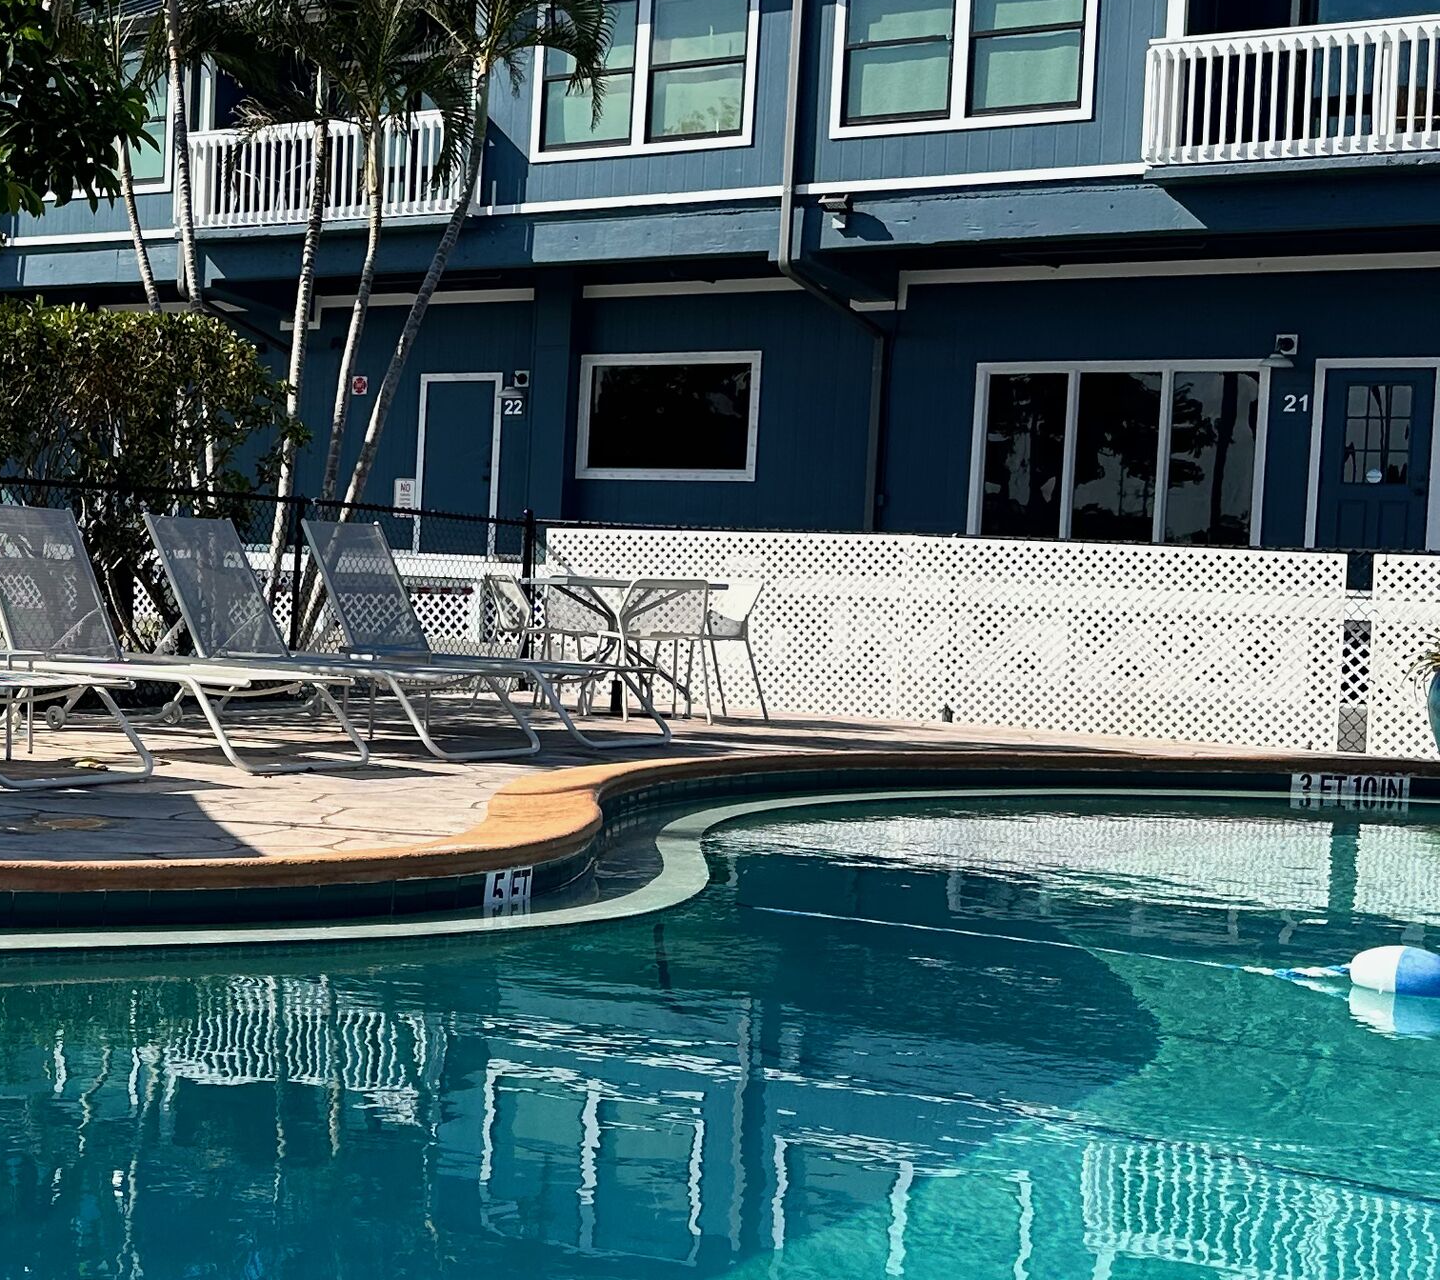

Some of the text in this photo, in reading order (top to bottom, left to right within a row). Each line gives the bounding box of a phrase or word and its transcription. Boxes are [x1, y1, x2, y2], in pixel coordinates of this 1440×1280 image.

[504, 400, 522, 415] 22
[1283, 394, 1308, 412] 21
[493, 869, 531, 898] 5 FT
